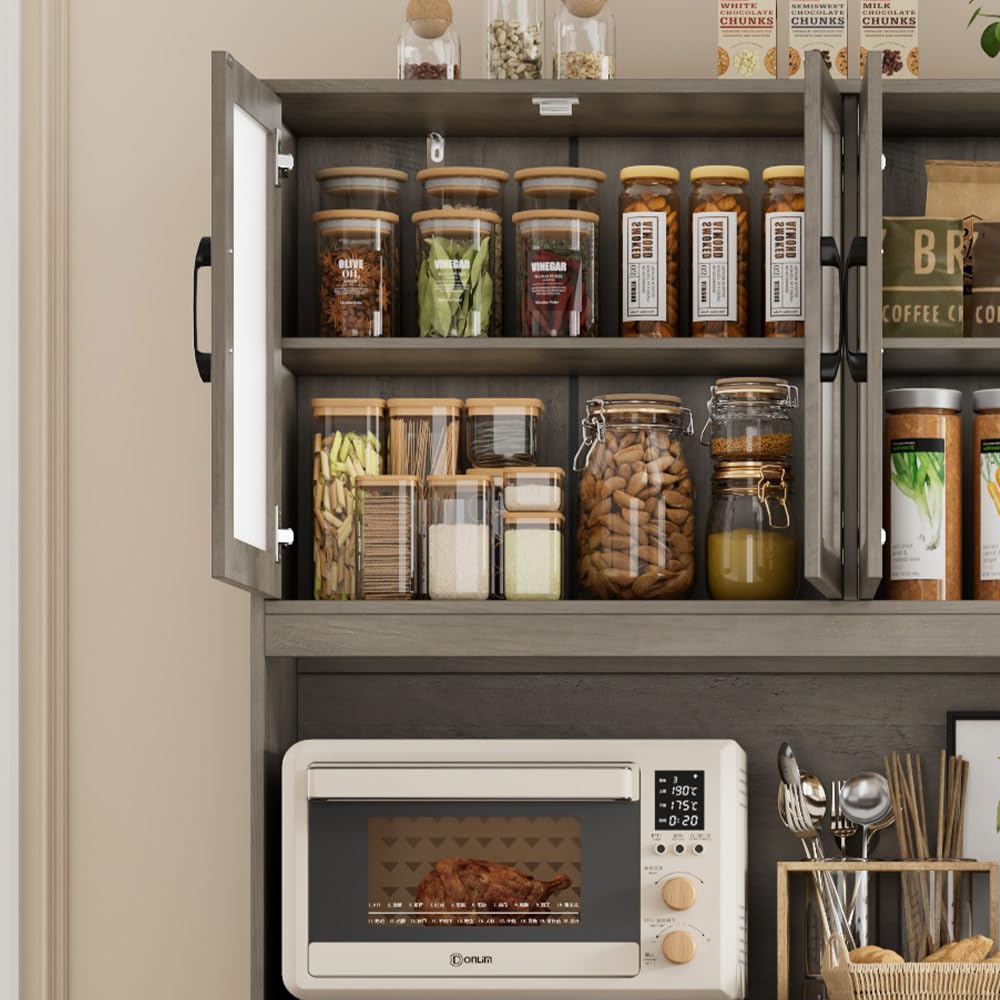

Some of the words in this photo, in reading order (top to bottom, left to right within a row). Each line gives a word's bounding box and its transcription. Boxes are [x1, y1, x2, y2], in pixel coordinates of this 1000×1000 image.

[720, 17, 774, 25] CHUNKS
[791, 17, 845, 25] CHUNKS
[862, 17, 916, 25] CHUNKS
[338, 258, 364, 270] OLIVE
[434, 258, 471, 270] VINEGAR
[531, 262, 567, 272] VINEGAR
[342, 269, 361, 279] OIL
[883, 304, 939, 323] COFFEE
[673, 776, 678, 784] 3
[668, 815, 699, 826] 0:20
